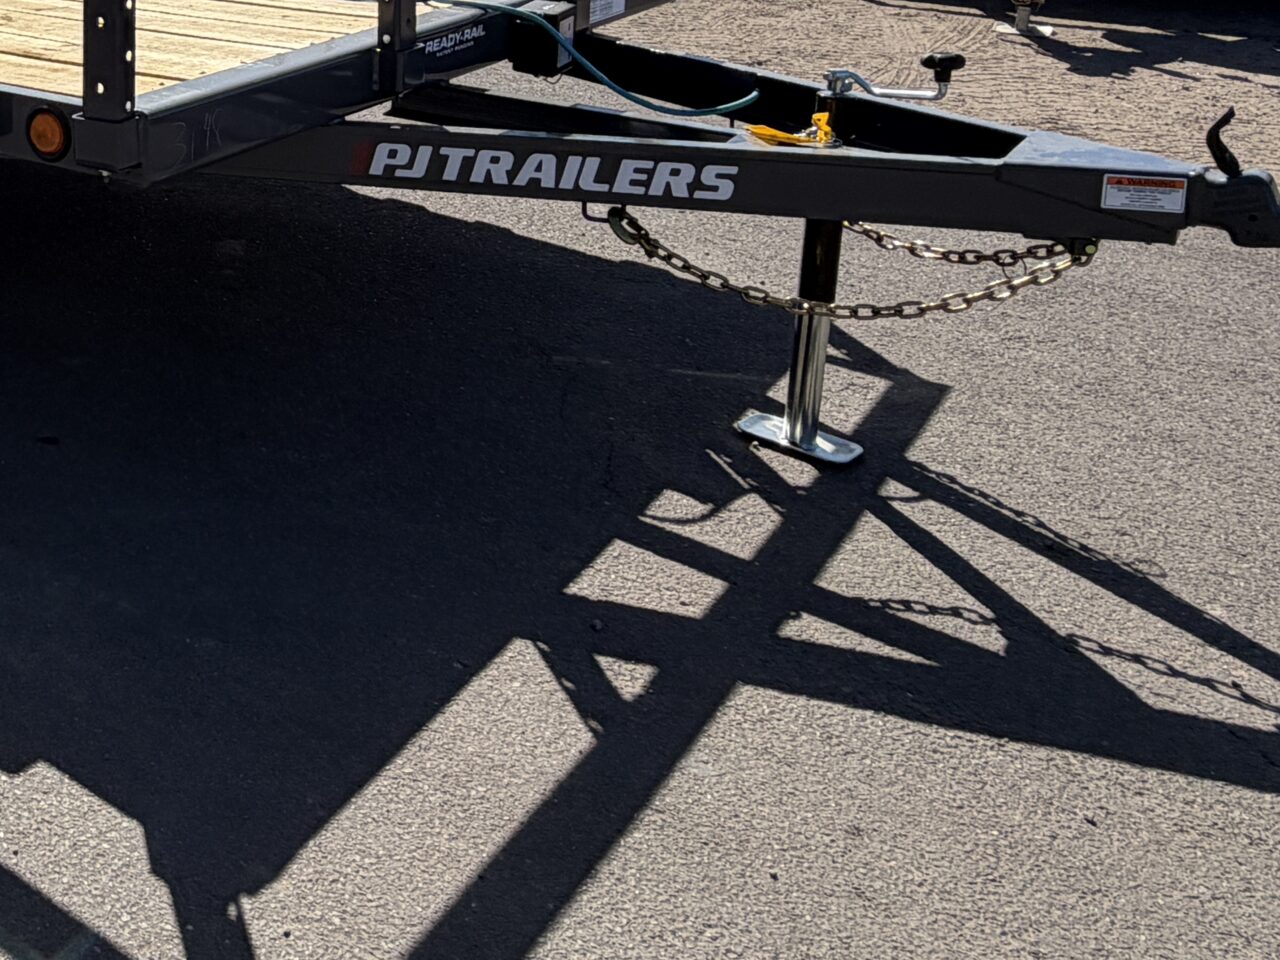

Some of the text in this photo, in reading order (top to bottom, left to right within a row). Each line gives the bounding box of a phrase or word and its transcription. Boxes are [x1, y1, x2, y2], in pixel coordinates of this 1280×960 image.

[425, 24, 486, 54] READY-RAIL
[368, 142, 739, 201] PJ TRAILERS
[1127, 178, 1176, 187] WARNING
